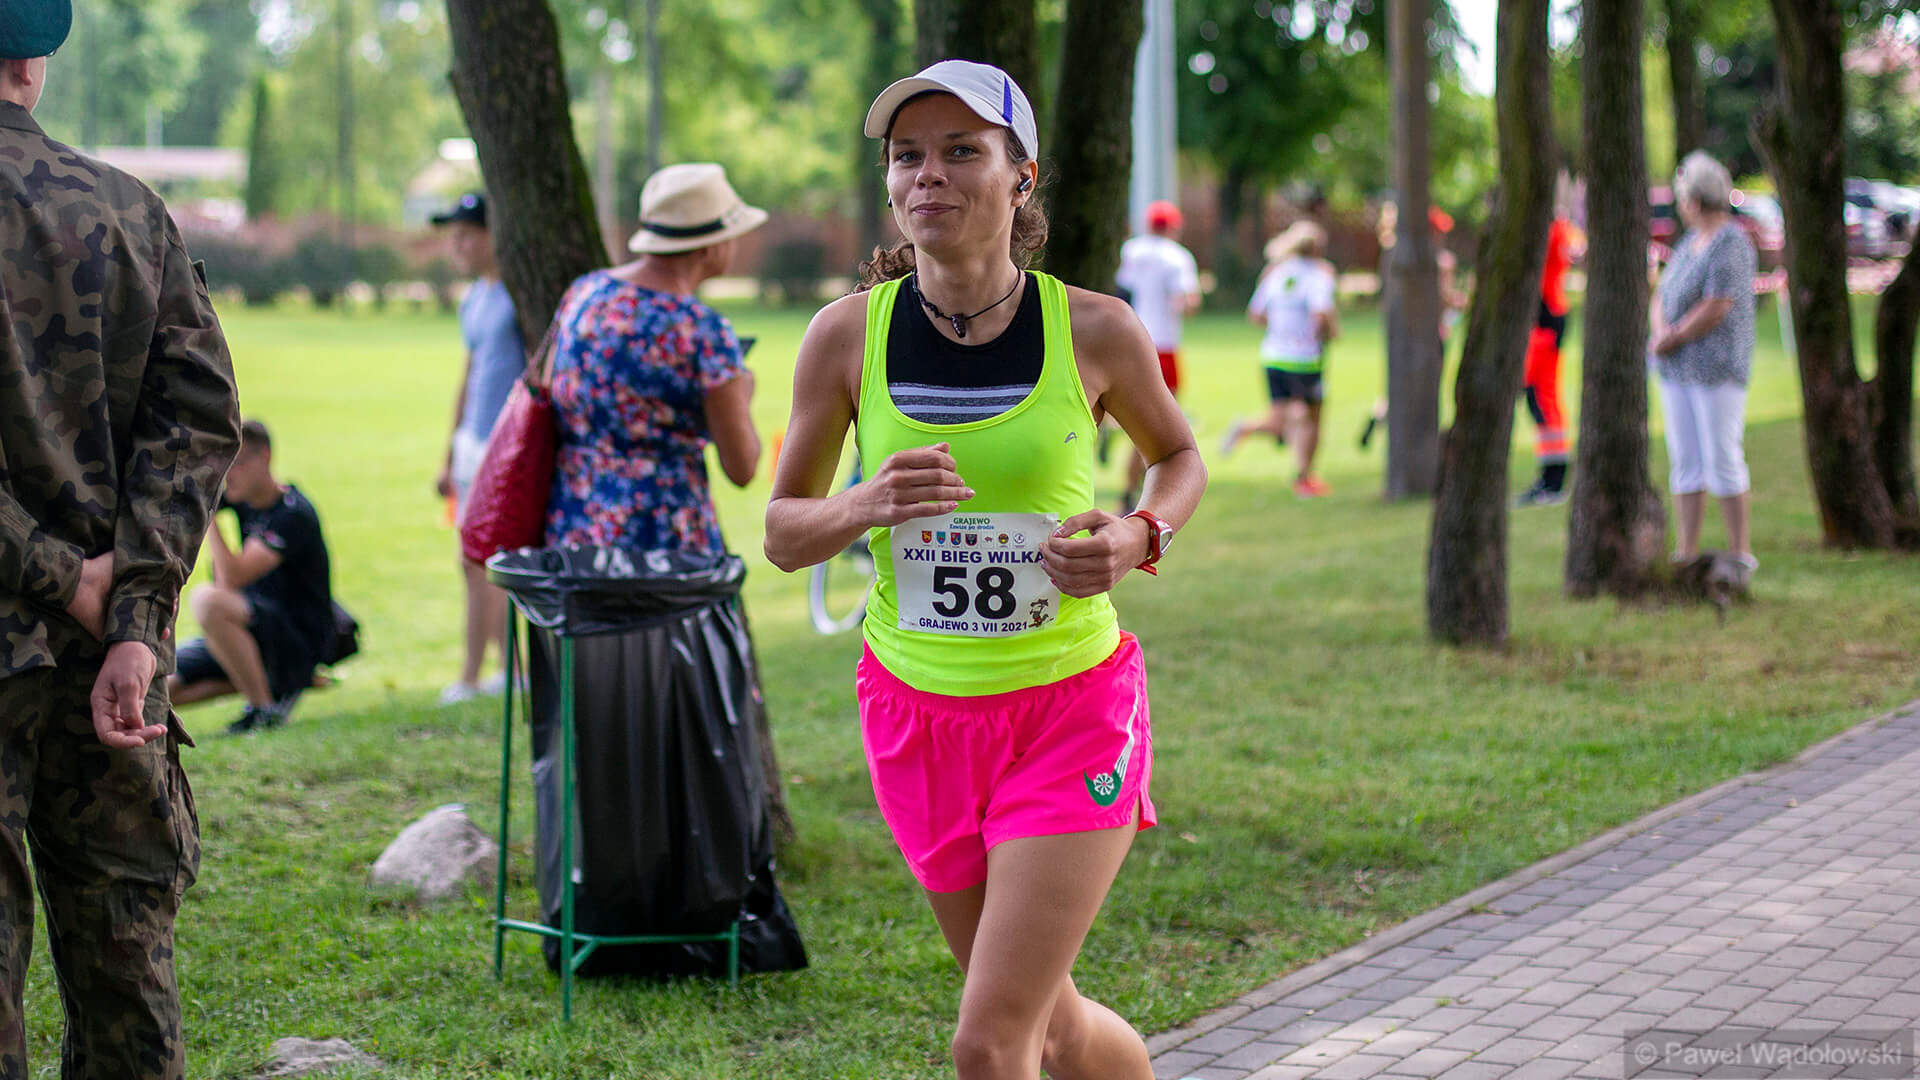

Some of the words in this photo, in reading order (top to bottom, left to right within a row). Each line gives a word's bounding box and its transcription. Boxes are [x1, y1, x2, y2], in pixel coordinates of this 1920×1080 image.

[953, 517, 991, 525] GRAJEWO
[903, 548, 936, 562] XXII
[941, 550, 982, 564] BIEG
[988, 551, 1044, 564] WILKA
[932, 565, 1017, 620] 58
[919, 617, 969, 632] GRAJEWO
[972, 622, 979, 632] 3
[982, 622, 998, 632] VII
[1001, 621, 1027, 632] 2021
